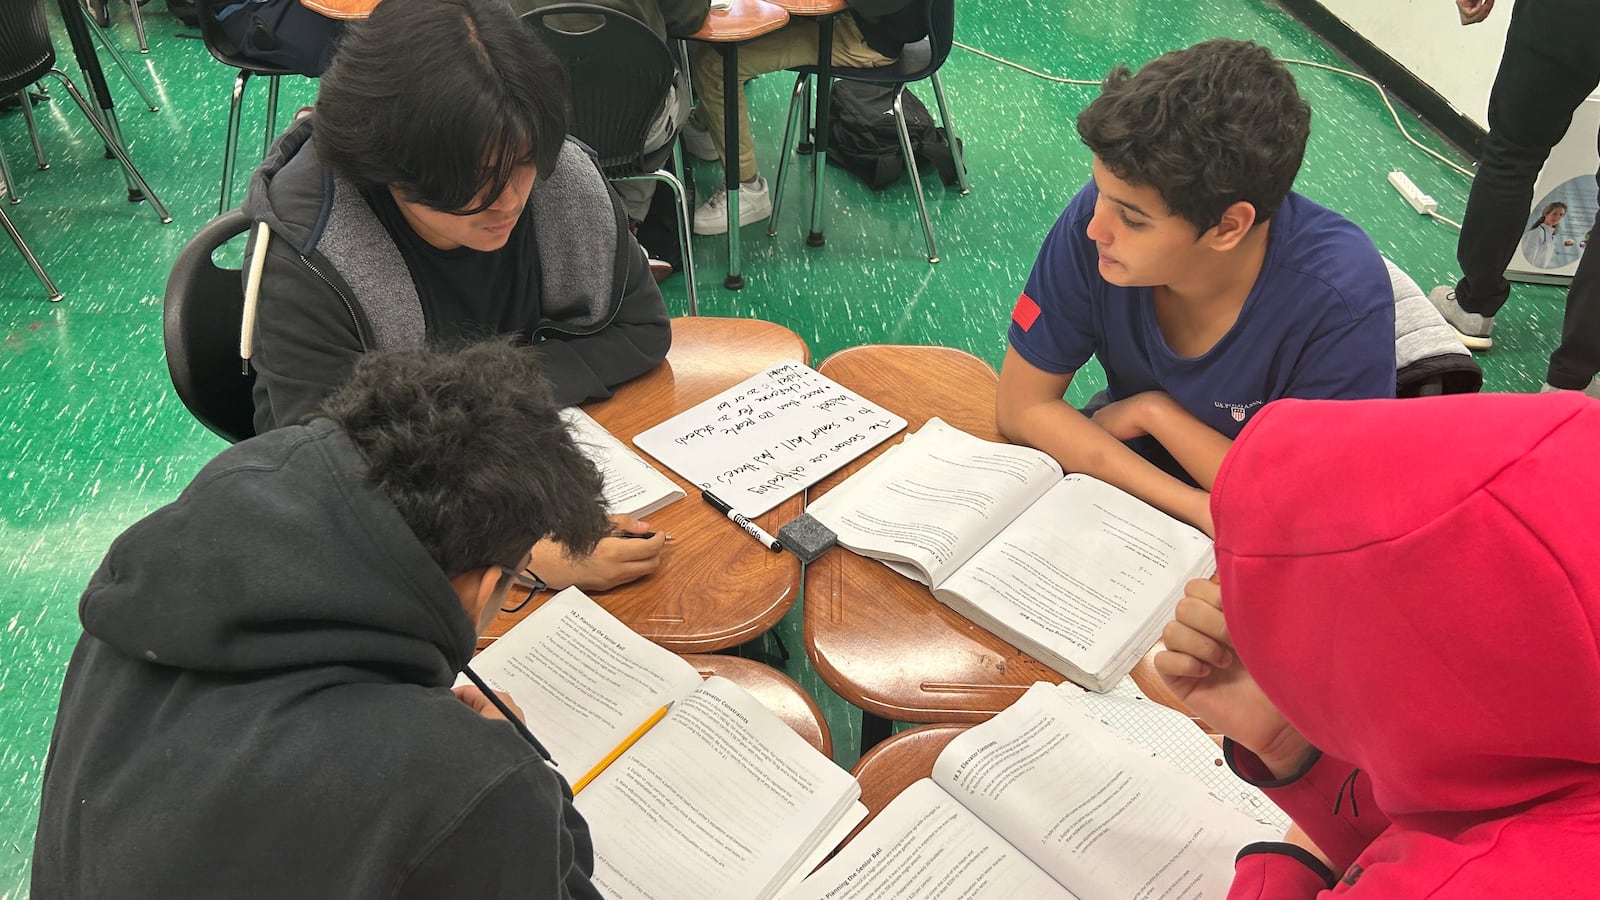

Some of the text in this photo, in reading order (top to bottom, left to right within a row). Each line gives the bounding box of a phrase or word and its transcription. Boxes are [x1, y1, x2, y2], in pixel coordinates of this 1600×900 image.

[868, 419, 890, 429] The
[578, 616, 597, 632] Planning
[595, 629, 604, 637] the
[602, 633, 617, 645] Senior
[615, 643, 626, 651] Ball
[1053, 629, 1076, 644] Planning
[721, 700, 749, 723] Constraints
[825, 880, 849, 898] Planning
[847, 872, 856, 881] the
[855, 857, 871, 873] Senior
[871, 847, 881, 858] Ball
